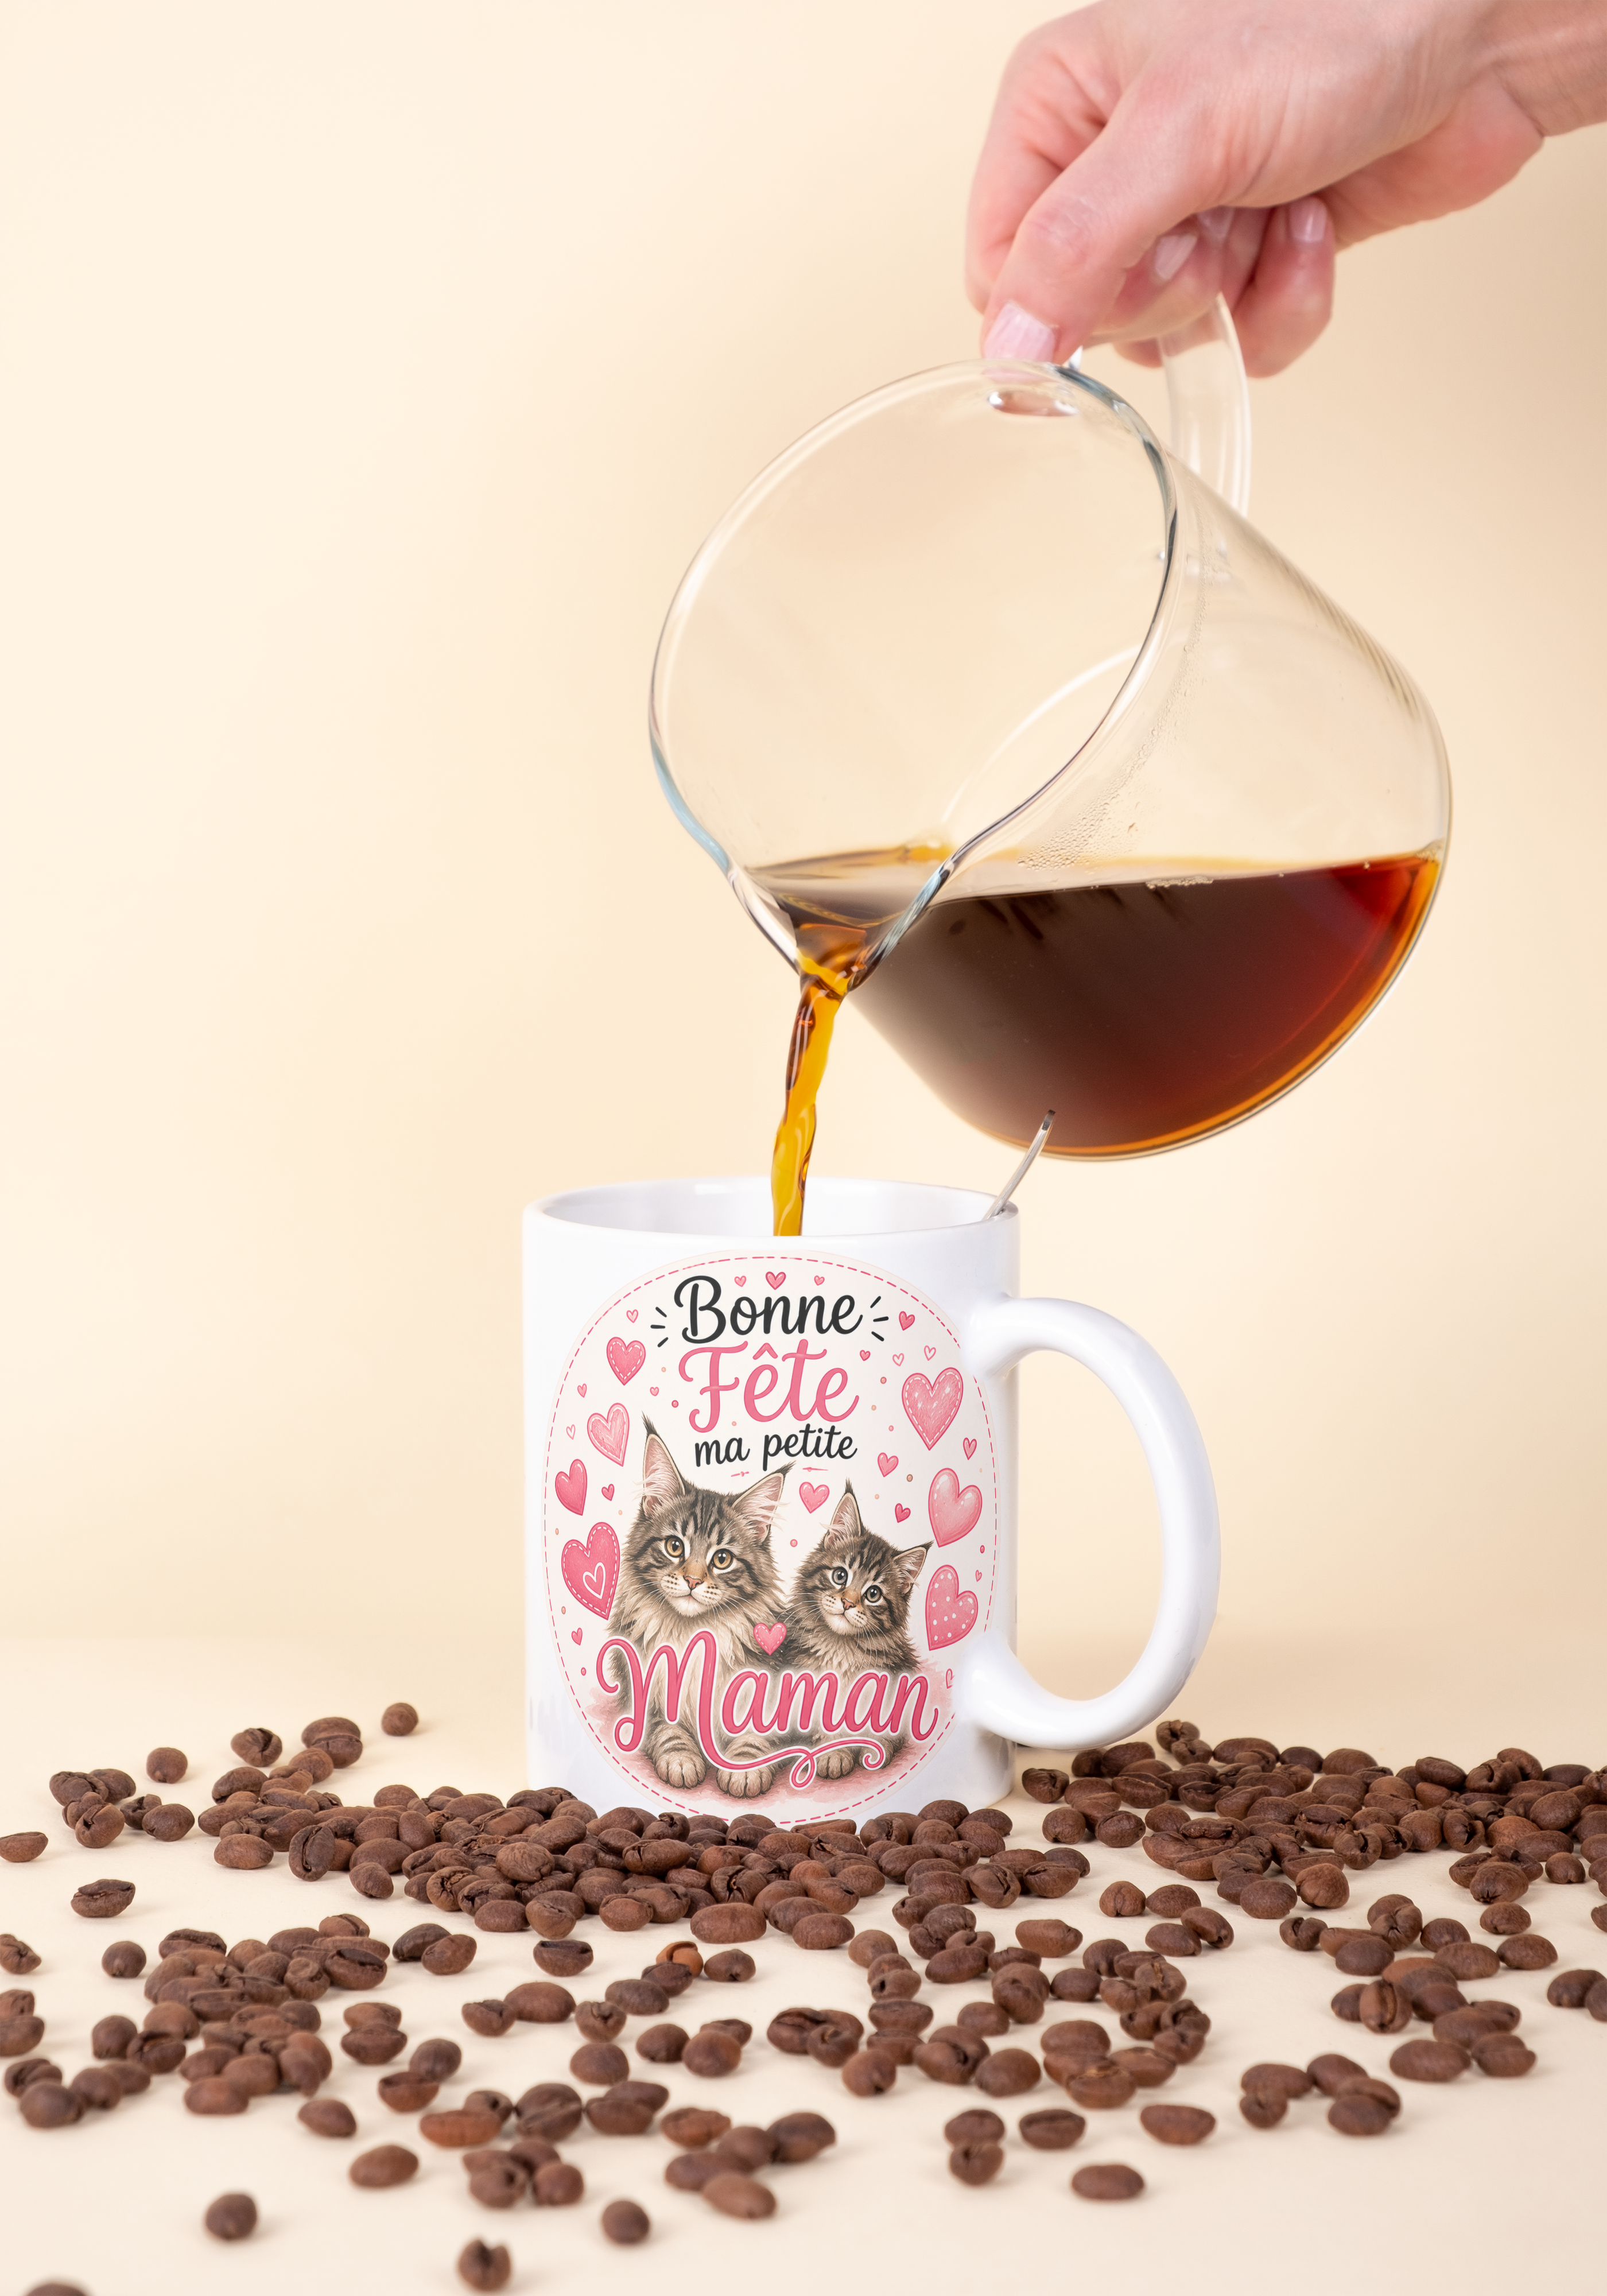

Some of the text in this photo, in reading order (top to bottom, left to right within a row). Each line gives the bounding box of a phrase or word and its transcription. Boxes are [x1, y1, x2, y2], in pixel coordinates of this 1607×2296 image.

[674, 1275, 863, 1344] Bonne
[678, 1339, 860, 1433] Fête
[694, 1423, 858, 1471] ma petite
[596, 1630, 938, 1787] Maman
